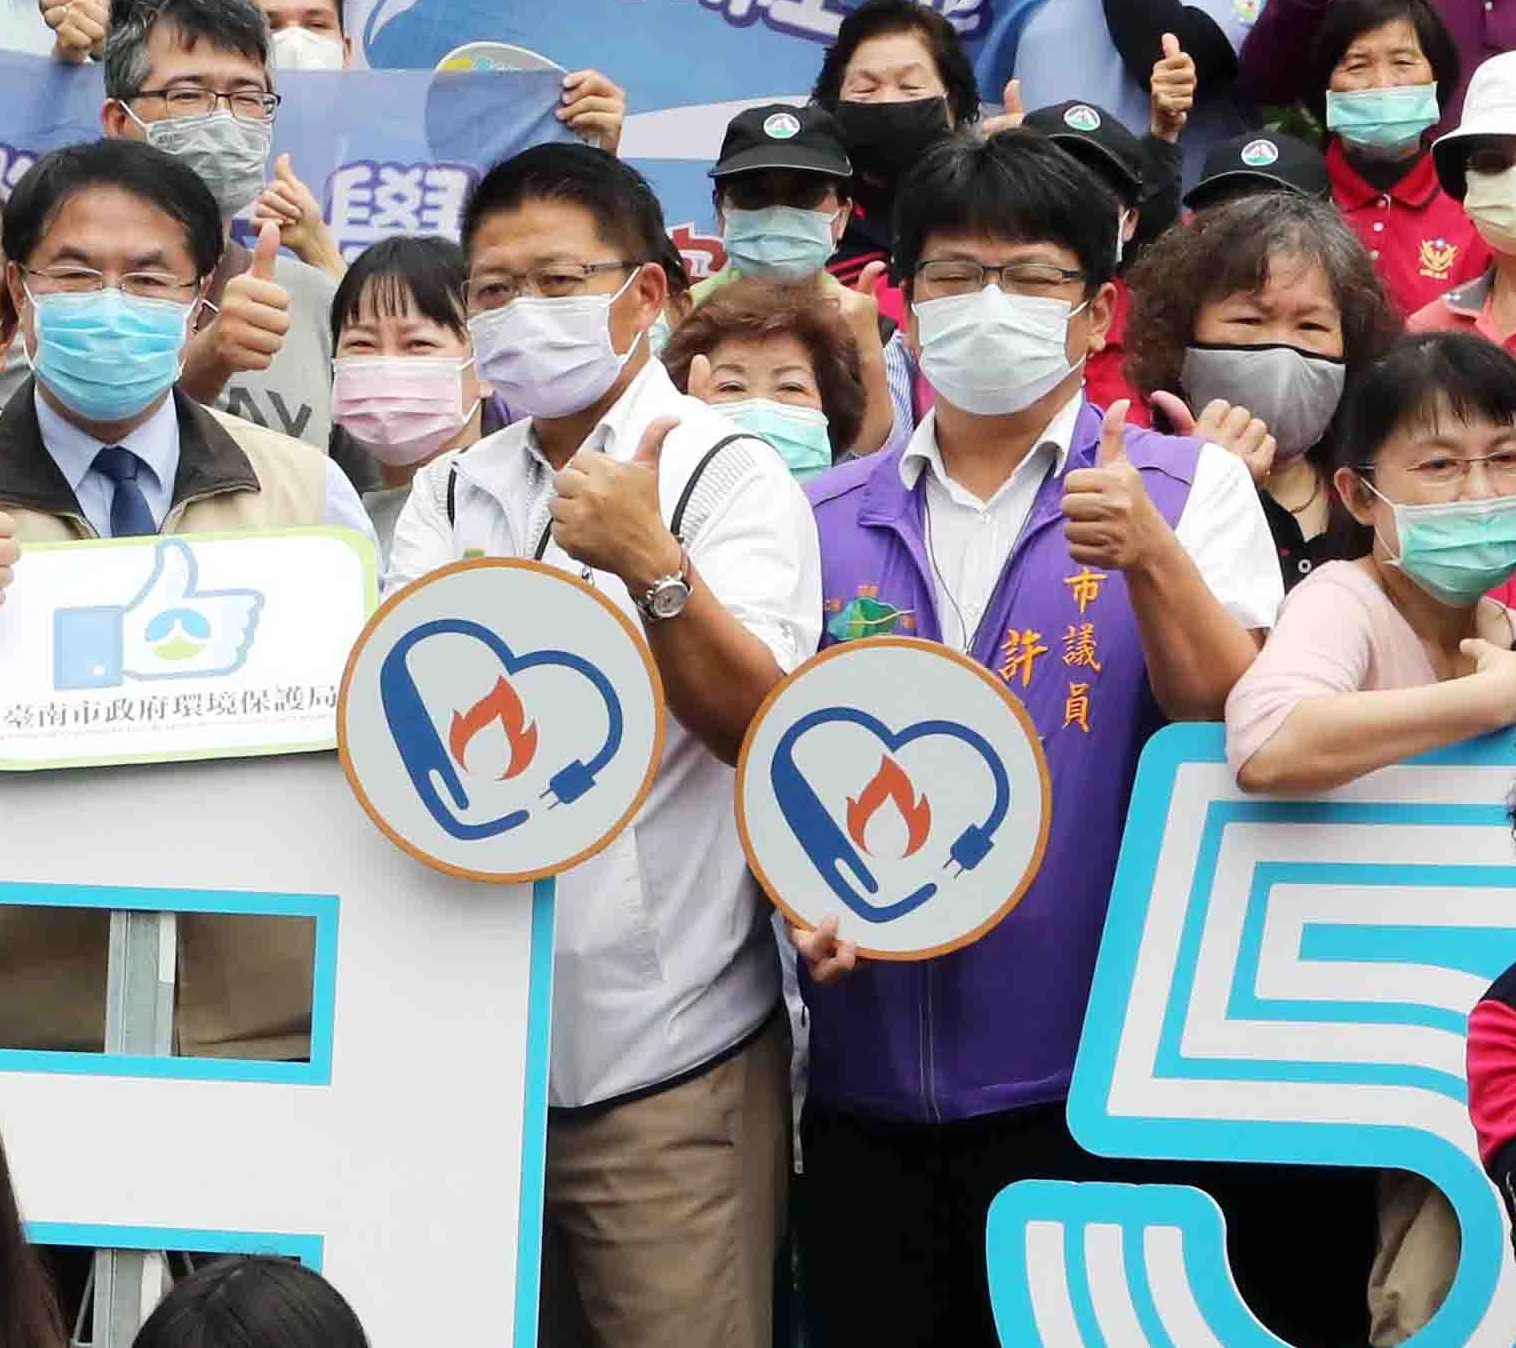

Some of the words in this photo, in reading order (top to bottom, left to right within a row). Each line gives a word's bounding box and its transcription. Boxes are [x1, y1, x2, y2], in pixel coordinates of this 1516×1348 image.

[998, 628, 1048, 688] 許
[1062, 566, 1109, 734] 市議員
[3, 684, 337, 729] 臺南市政府環境保護局
